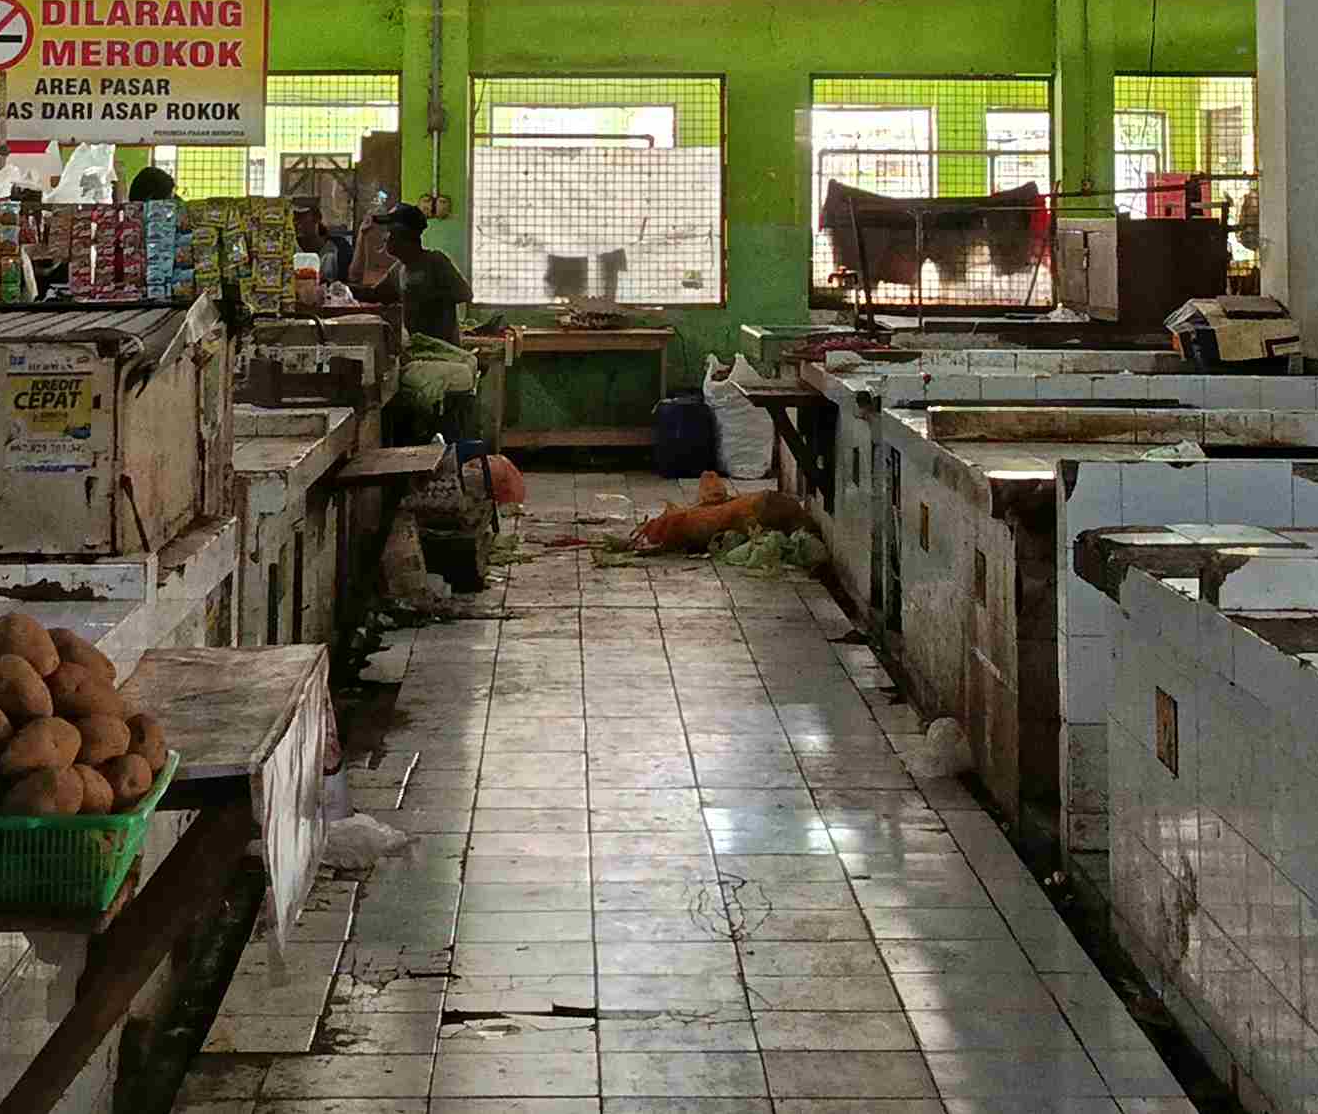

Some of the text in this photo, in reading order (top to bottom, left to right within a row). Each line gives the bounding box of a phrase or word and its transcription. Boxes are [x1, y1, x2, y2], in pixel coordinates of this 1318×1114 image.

[41, 39, 243, 68] MEROKOK
[34, 77, 171, 96] AREA PASAR
[41, 102, 93, 121] DARI
[100, 102, 158, 121] ASAP
[166, 102, 241, 121] ROKOK
[30, 379, 84, 391] KREDIT
[13, 391, 83, 410] CEPAT
